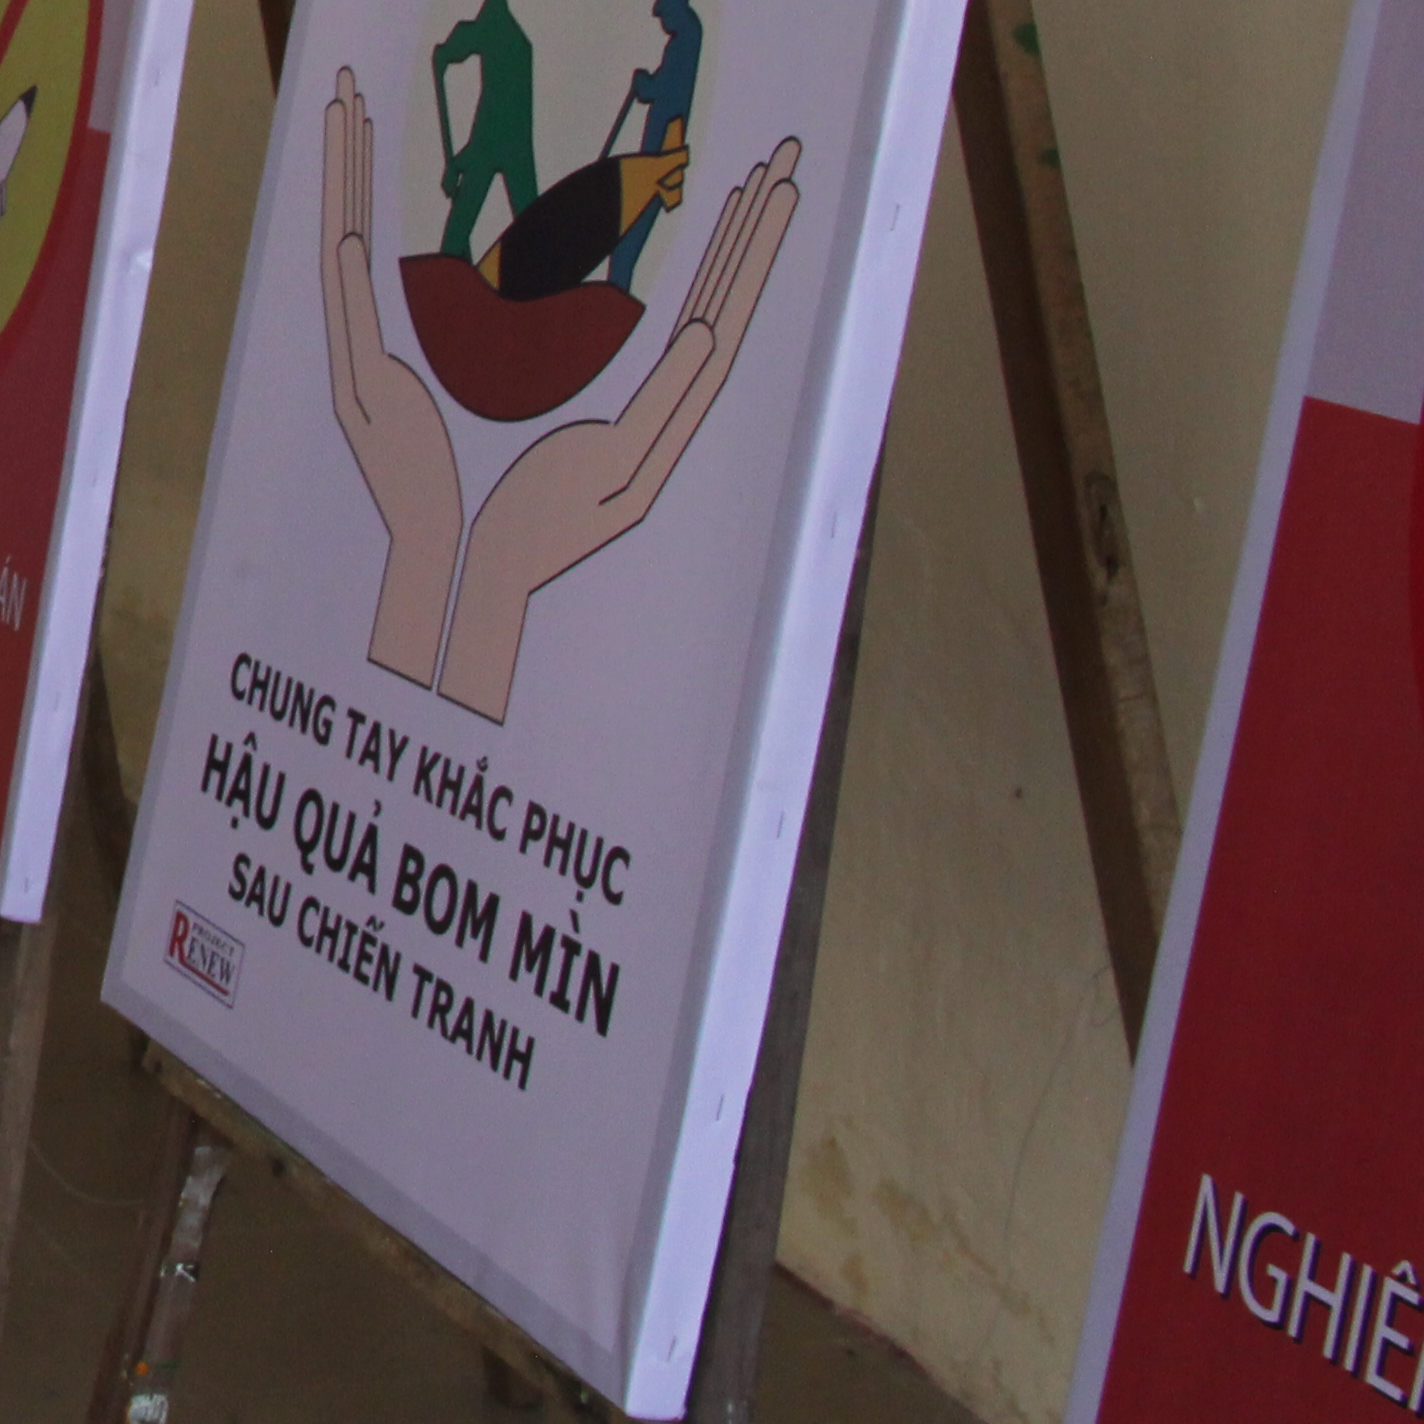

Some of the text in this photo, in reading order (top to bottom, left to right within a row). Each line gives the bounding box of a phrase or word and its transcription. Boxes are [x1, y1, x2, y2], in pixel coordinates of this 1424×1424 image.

[200, 730, 620, 1038] HẬU QUẢ BOM MÌN
[229, 651, 631, 907] CHUNG TAY KHẮC PHỤC
[169, 909, 236, 988] RENEW
[227, 852, 292, 928] SAU
[410, 962, 535, 1092] TRANH
[1182, 1172, 1424, 1418] NGHIÊ
